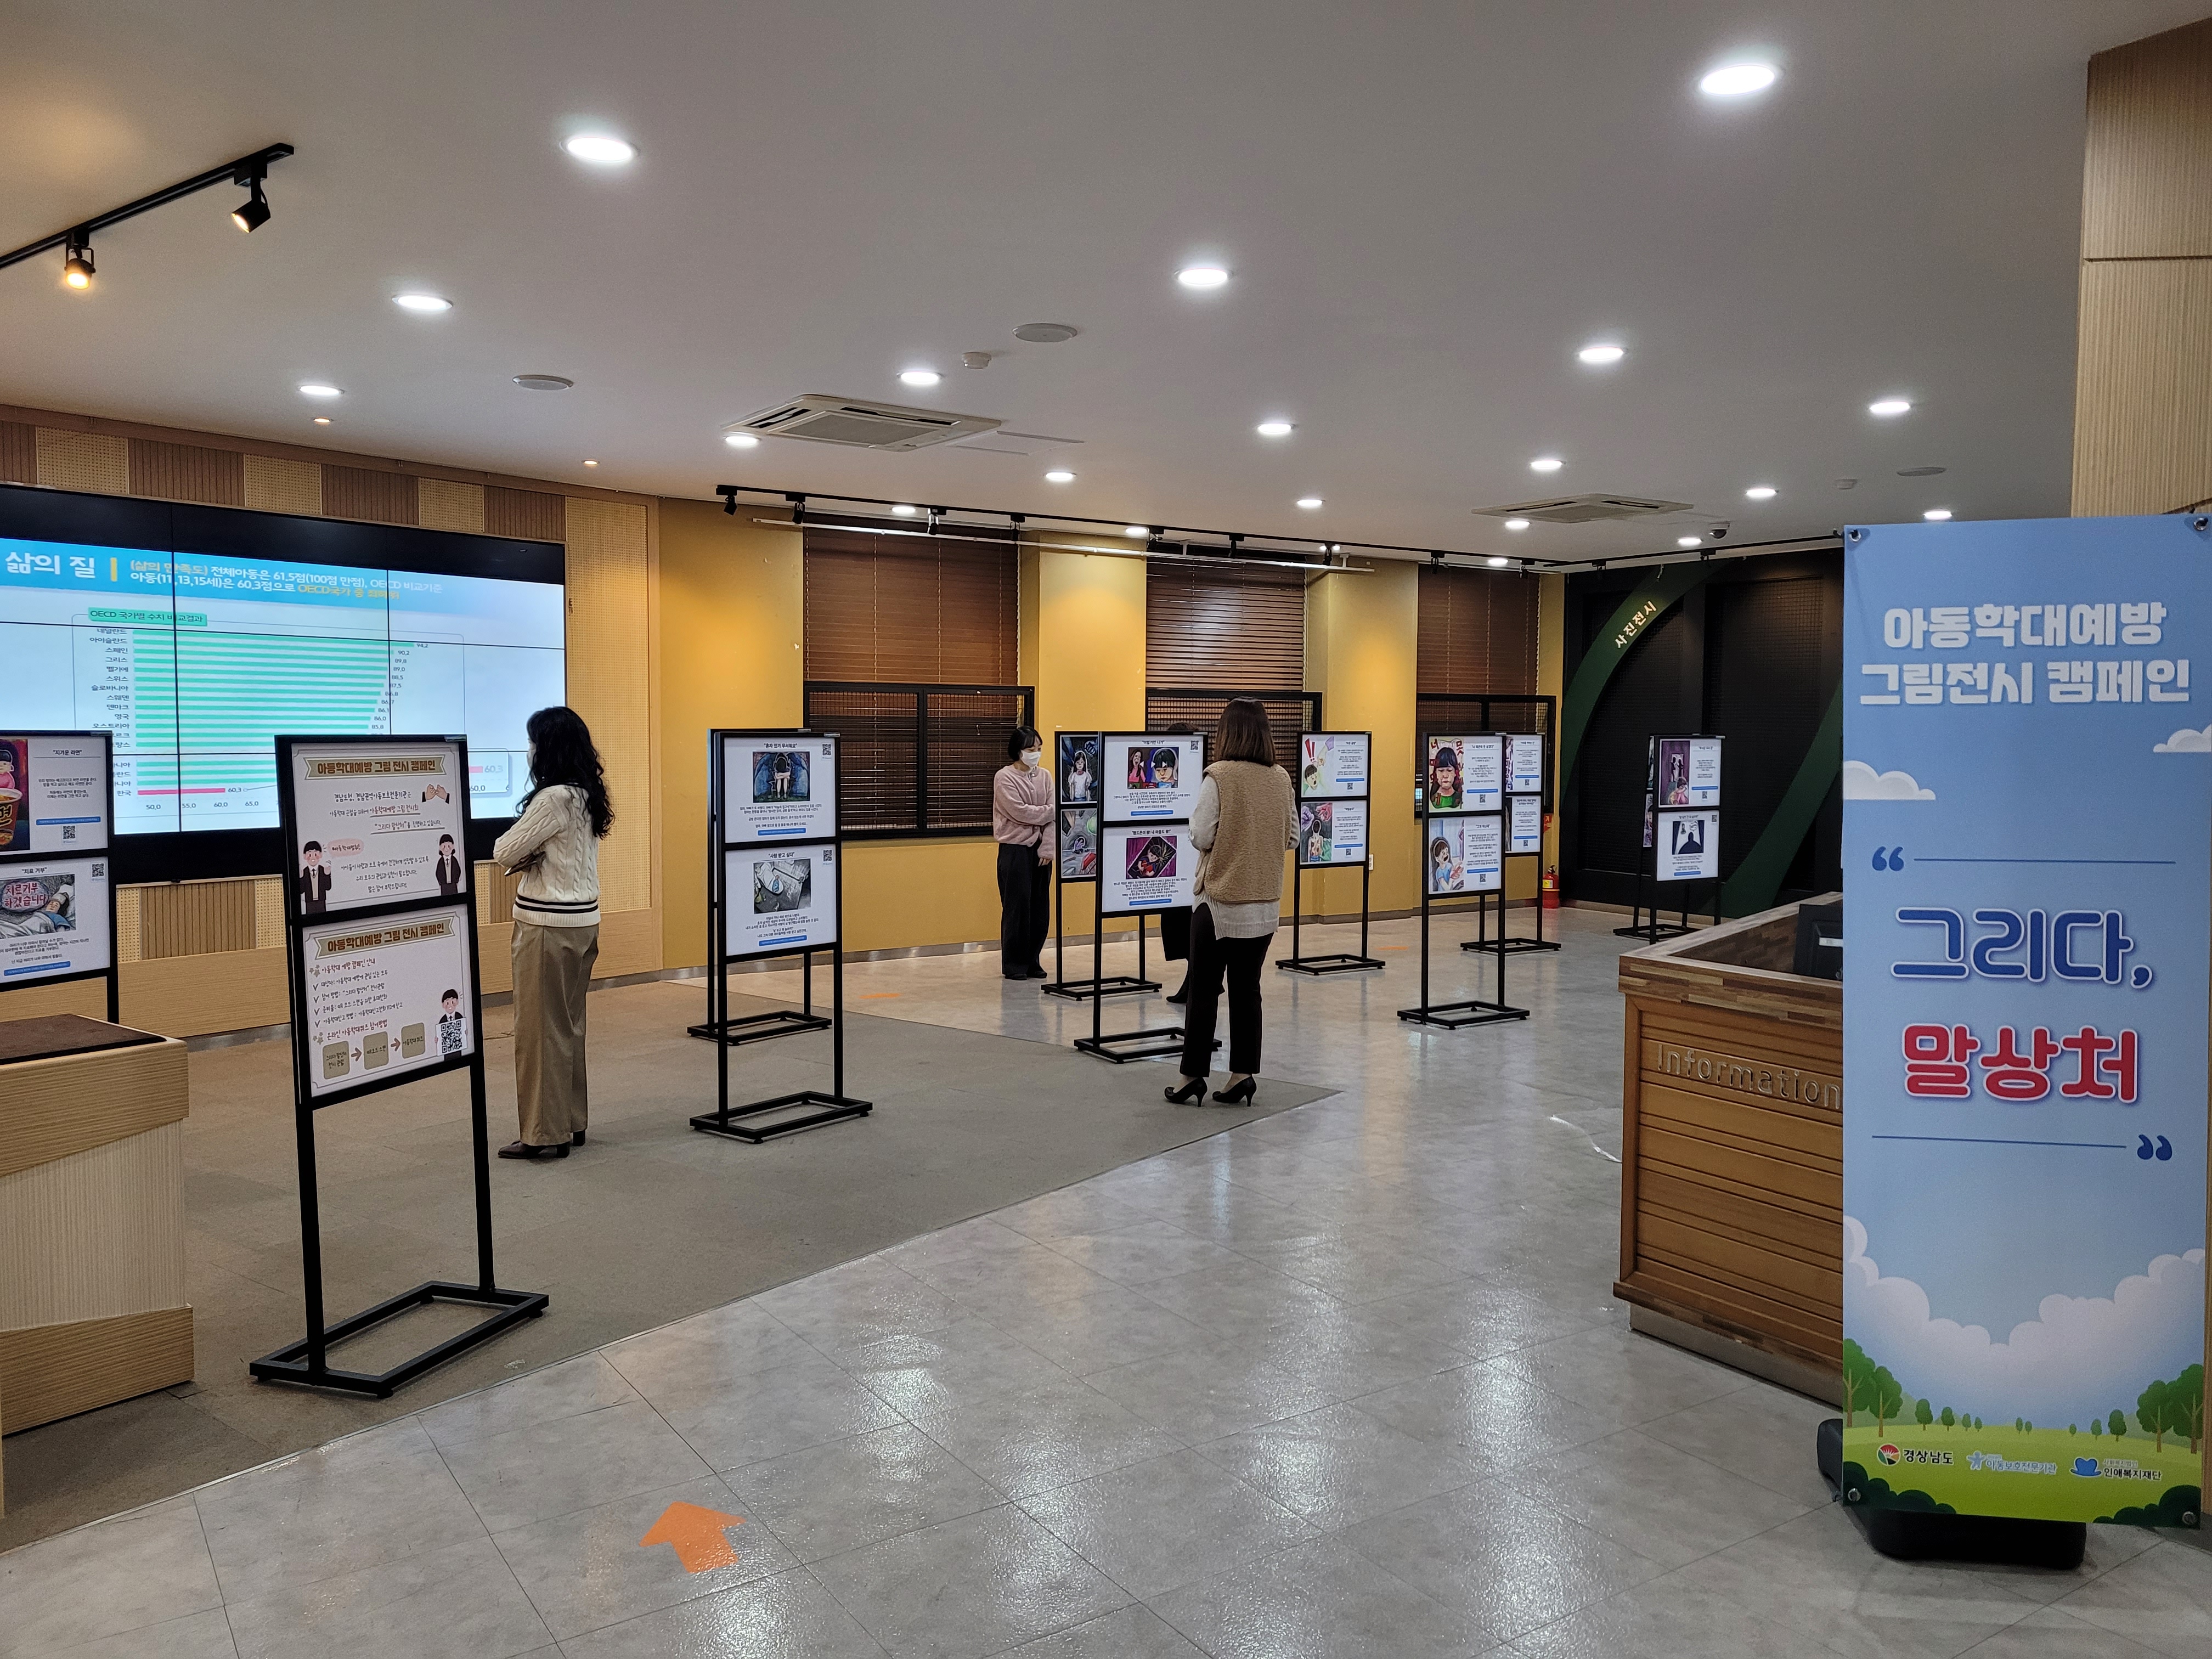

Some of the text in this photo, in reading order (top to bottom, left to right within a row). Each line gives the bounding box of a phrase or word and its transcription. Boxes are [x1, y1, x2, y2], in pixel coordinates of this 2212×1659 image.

[5, 551, 96, 579] 삶의 질
[130, 560, 160, 572] (삶의
[211, 566, 271, 580] 전체아동은
[273, 572, 337, 586] 61.5점(100점
[370, 579, 402, 589] OECD
[403, 582, 443, 594] 비교기준
[237, 579, 296, 592] 60.3점으로
[297, 584, 351, 596] OECD국가
[119, 612, 145, 620] 국가별
[1615, 600, 1657, 648] 사진전시
[1883, 602, 2167, 648] 아동학대예방
[1860, 659, 2190, 704] 그림전시 캠페인
[317, 760, 436, 774] 아동학대예방 그림 전시 캠페인
[5, 882, 38, 896] 치료거부
[4, 894, 46, 909] 하겠습니다
[328, 923, 444, 952] 아동학대예방 그림 전시 캠페인
[1891, 907, 2153, 989] 그리다,
[321, 964, 341, 974] 아동학대
[326, 1030, 340, 1041] 온라인
[1902, 1023, 2138, 1103] 말상처
[1657, 1043, 1841, 1110] Information
[1902, 1448, 1955, 1465] 경상남도
[1987, 1459, 2056, 1474] 아동보호전문기관
[2104, 1468, 2162, 1481] 인애복지재단
